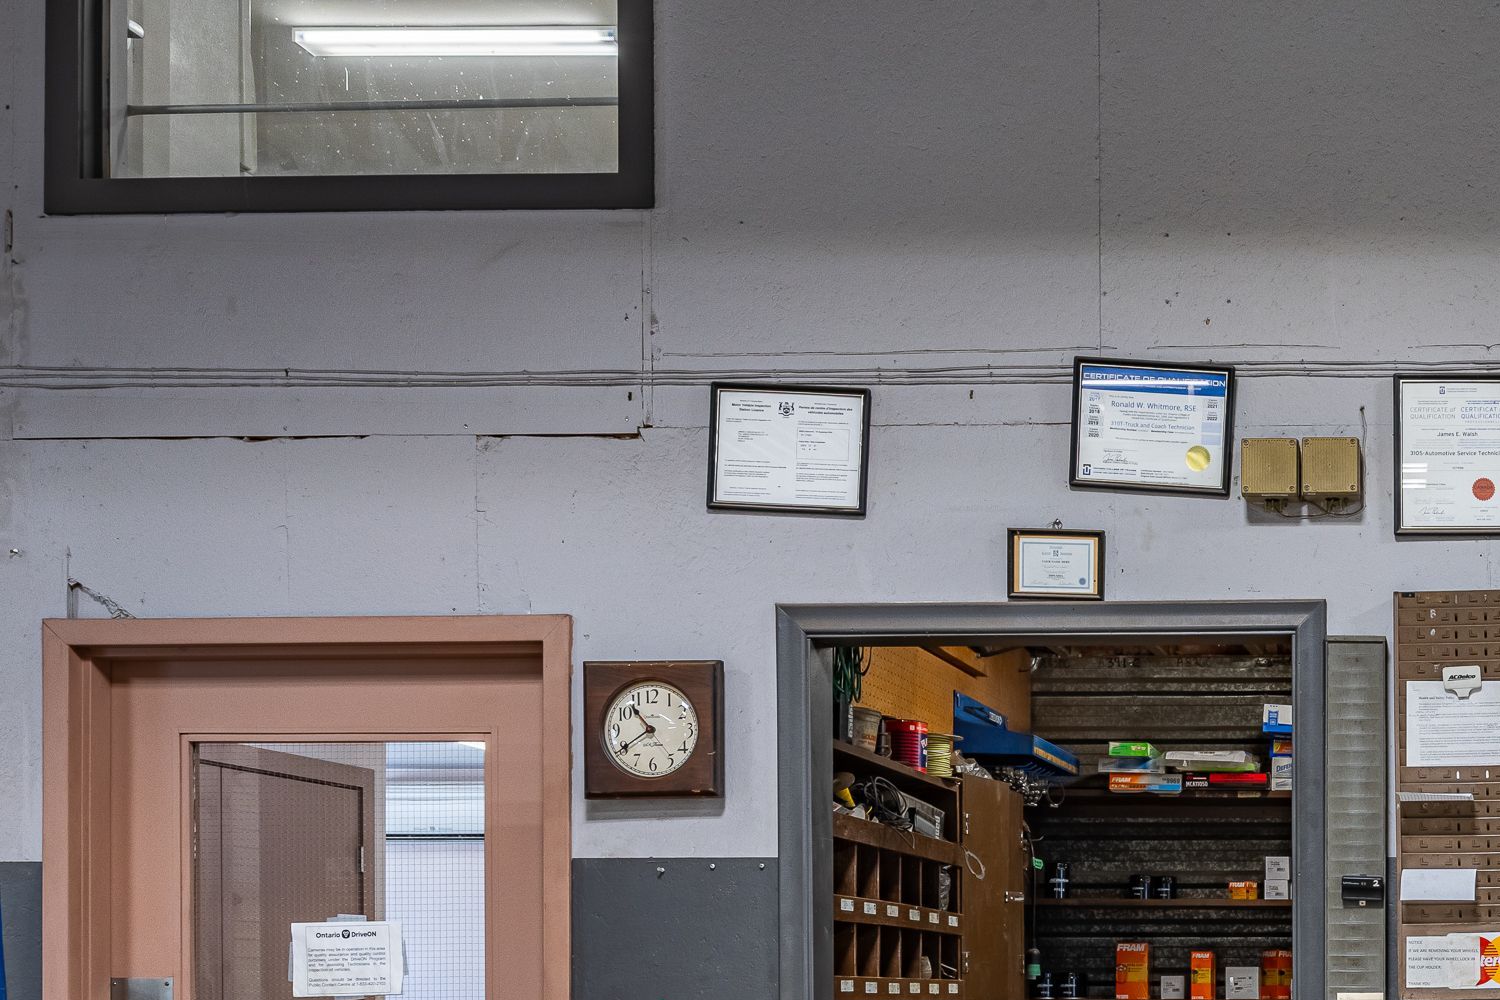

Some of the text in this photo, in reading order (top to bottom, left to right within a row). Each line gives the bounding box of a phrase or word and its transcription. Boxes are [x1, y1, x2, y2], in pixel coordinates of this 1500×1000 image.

[1111, 401, 1135, 409] Ronald
[1148, 403, 1182, 411] Whitmore,
[646, 689, 659, 704] 12
[668, 693, 671, 706] 1
[619, 706, 632, 721] 10
[612, 724, 620, 738] 9
[687, 722, 694, 738] 3
[677, 741, 688, 754] 4
[634, 754, 640, 767] 7
[649, 757, 657, 771] 6
[667, 754, 674, 768] 5
